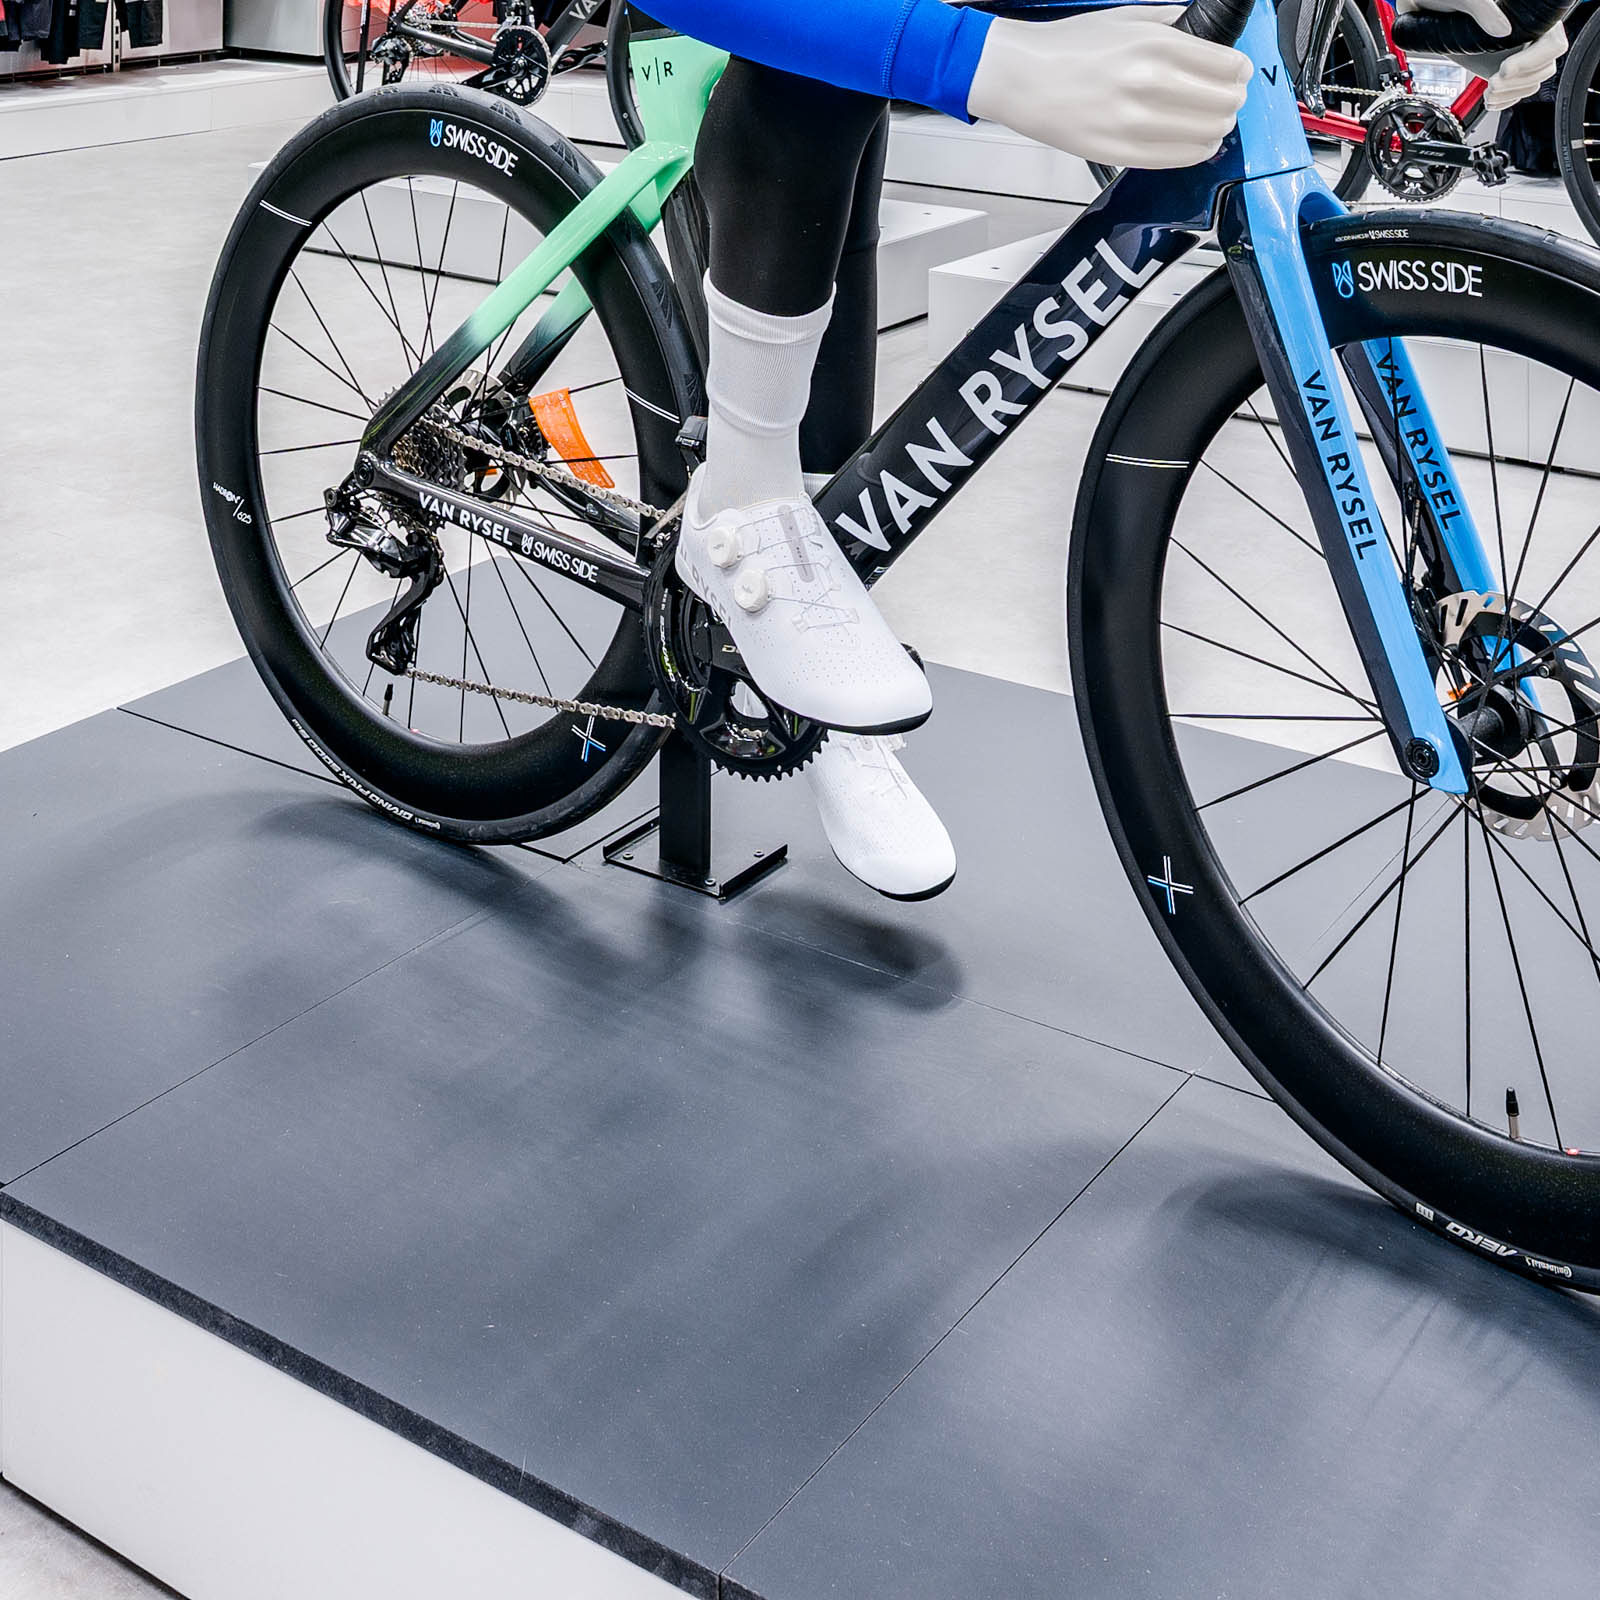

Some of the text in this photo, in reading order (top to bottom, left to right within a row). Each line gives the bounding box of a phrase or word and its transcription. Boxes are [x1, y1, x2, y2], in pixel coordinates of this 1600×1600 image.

[1261, 64, 1278, 87] V
[443, 124, 519, 177] SWISS SIDE
[1374, 229, 1394, 240] SWISS
[1394, 229, 1410, 239] SIDE
[1357, 259, 1483, 297] SWISS SIDE
[832, 236, 1166, 557] VAN RYSEL
[1375, 354, 1464, 532] VAN RYSEL
[1302, 369, 1380, 561] VAN RYSEL
[418, 491, 513, 546] VAN RYSEL
[533, 542, 599, 583] SWISS SIDE
[308, 738, 342, 773] 5000
[340, 772, 371, 797] PRIX
[369, 793, 413, 821] GRAND
[1446, 1221, 1518, 1257] AERO
